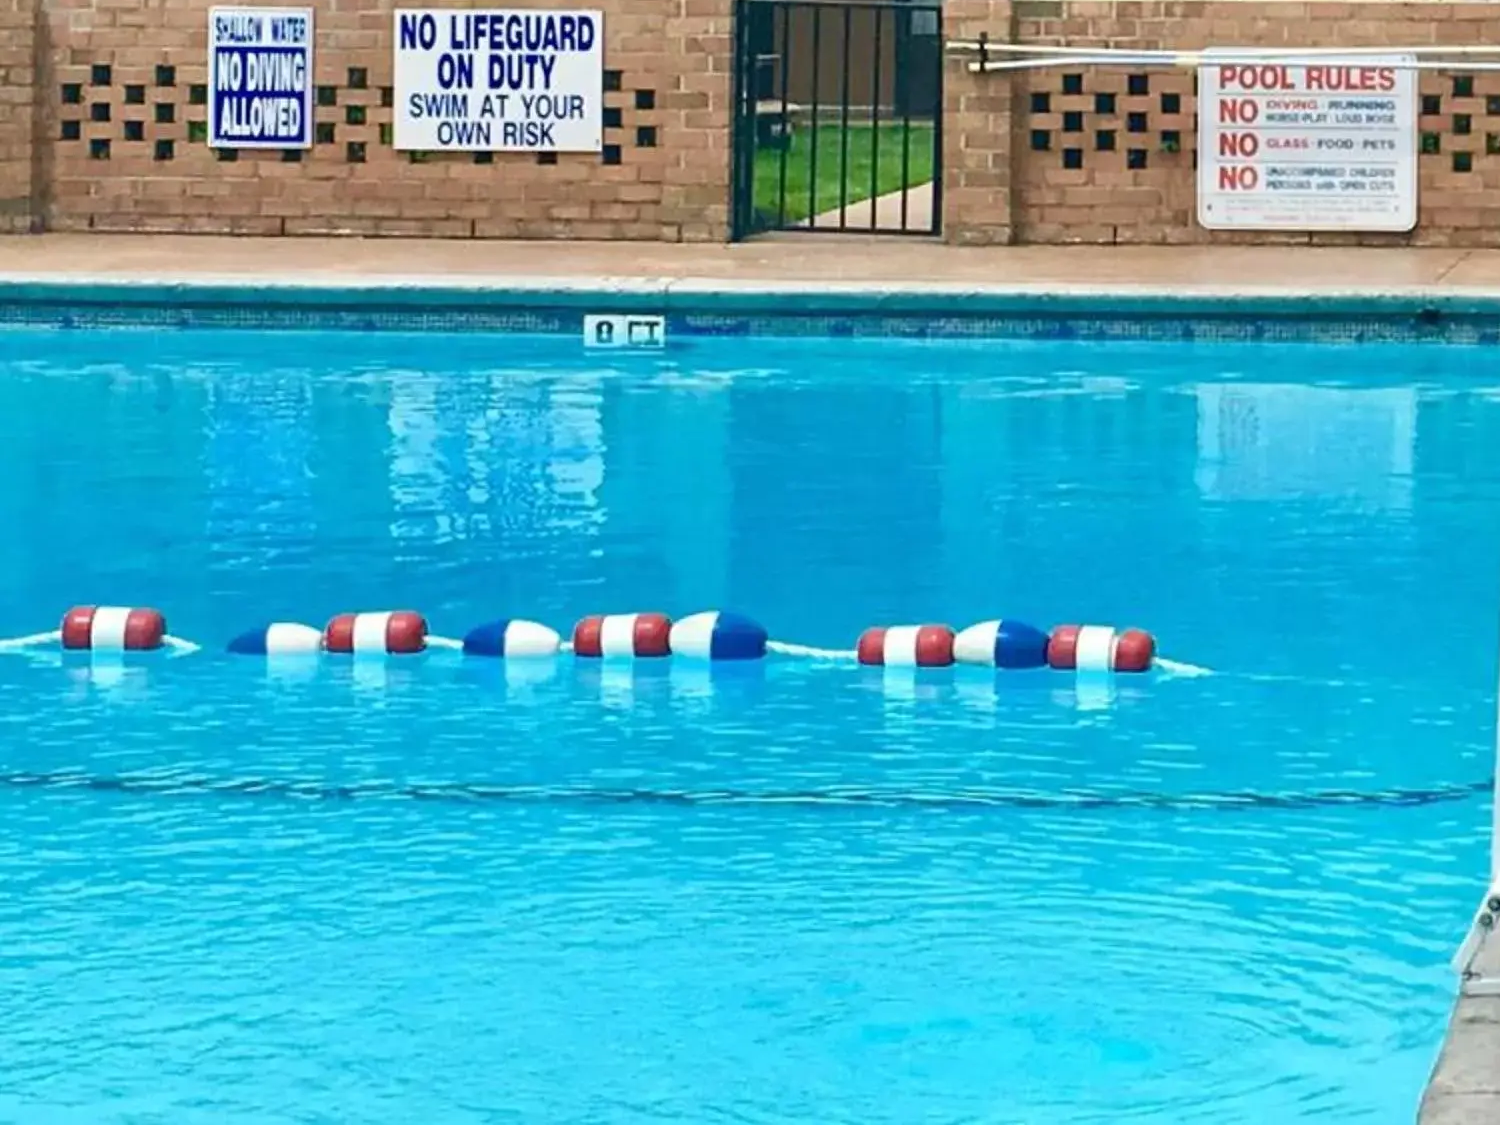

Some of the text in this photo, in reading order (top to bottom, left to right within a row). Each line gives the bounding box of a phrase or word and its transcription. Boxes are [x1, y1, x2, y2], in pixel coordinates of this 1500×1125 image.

[215, 16, 305, 43] SHALLOW WATER
[399, 13, 595, 52] NO LIFEGUARD
[217, 51, 305, 93] NO DIVING
[437, 54, 556, 91] ON DUTY
[1218, 64, 1396, 91] POOL RULES
[219, 96, 301, 138] ALLOWED
[409, 94, 585, 119] SWIM AT YOUR
[1218, 98, 1259, 123] NO
[1265, 99, 1396, 111] DIVING RUNNING
[436, 121, 555, 146] OWN RISK
[1218, 132, 1396, 157] NO GLASS FOOD PETS
[1218, 165, 1259, 190] NO
